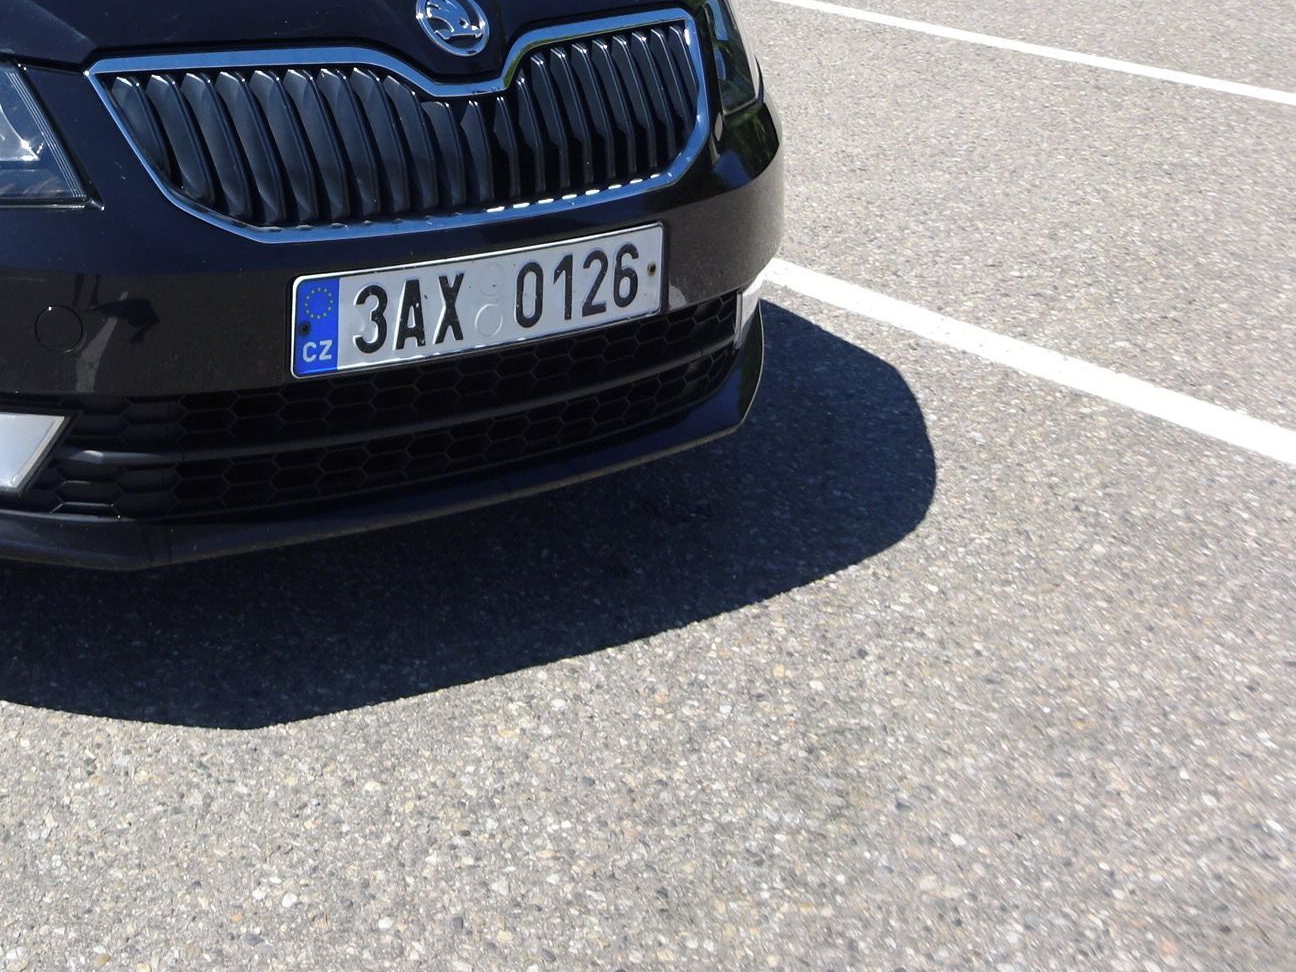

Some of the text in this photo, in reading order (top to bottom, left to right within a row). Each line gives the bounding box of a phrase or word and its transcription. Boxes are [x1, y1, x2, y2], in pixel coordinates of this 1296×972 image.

[352, 243, 640, 354] 3AX 0126
[301, 339, 333, 363] CZ
